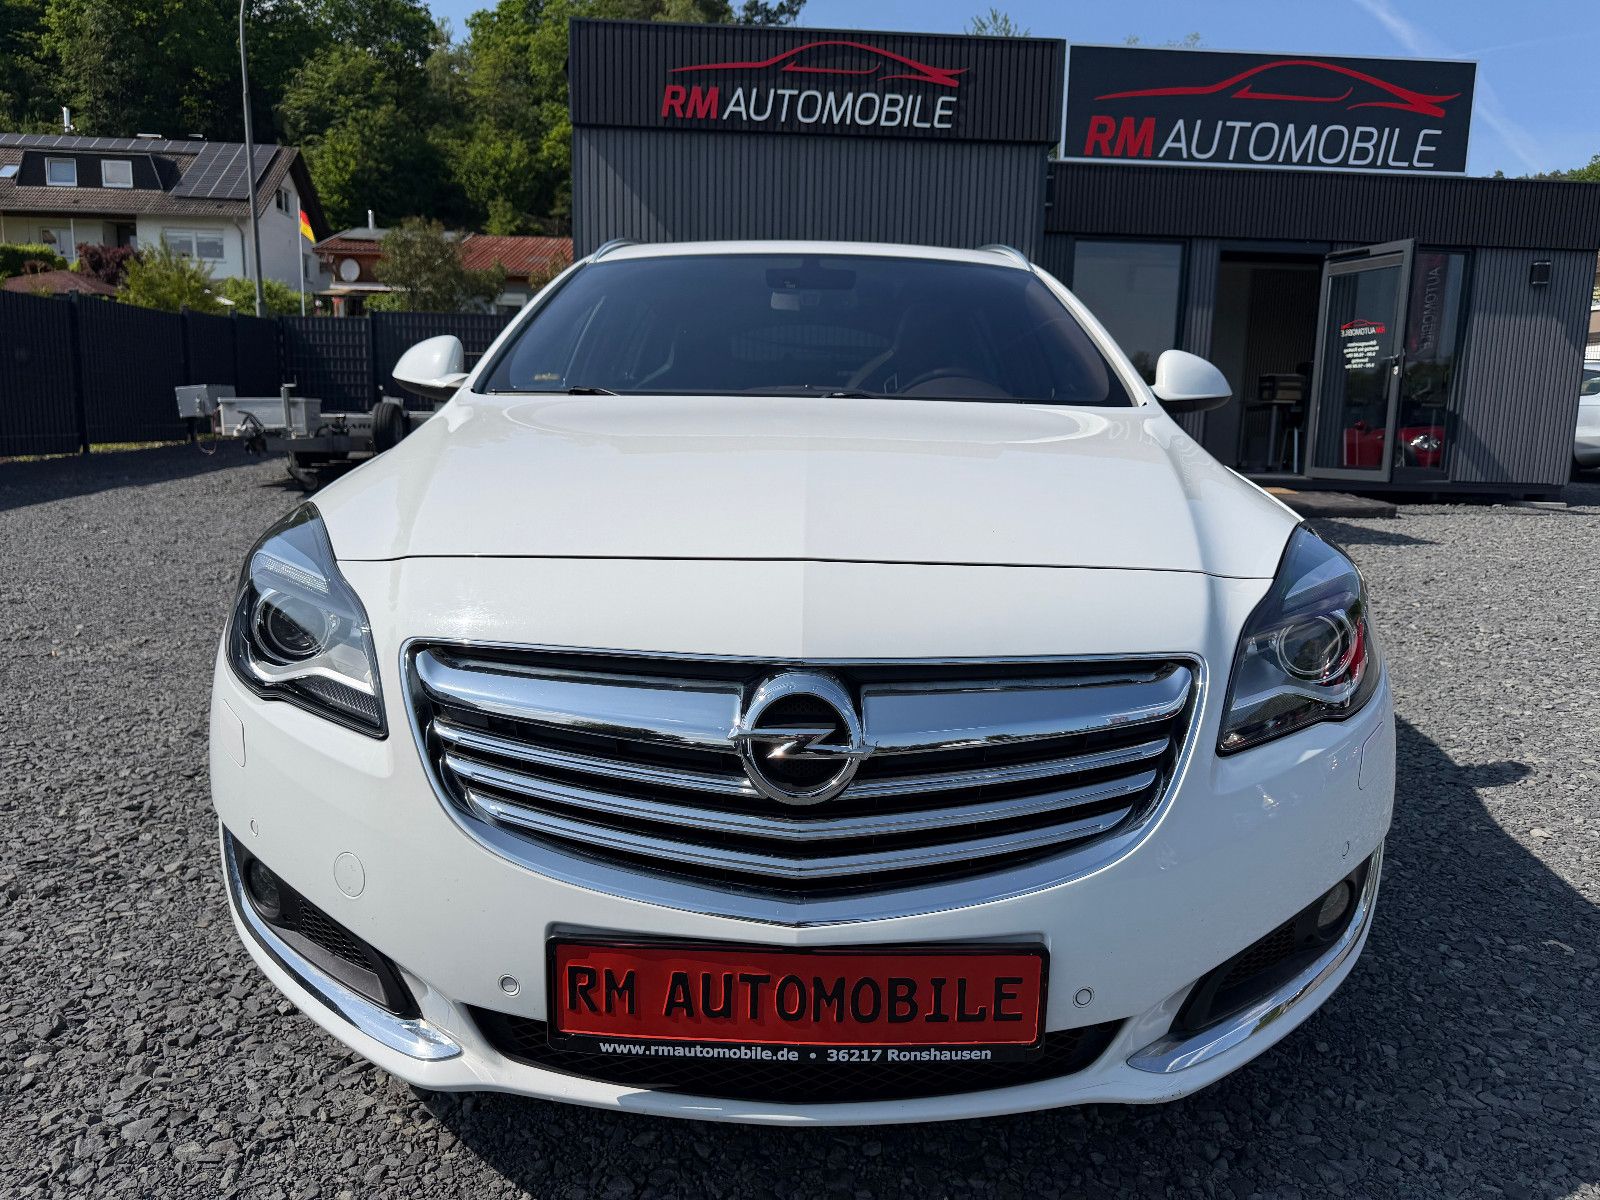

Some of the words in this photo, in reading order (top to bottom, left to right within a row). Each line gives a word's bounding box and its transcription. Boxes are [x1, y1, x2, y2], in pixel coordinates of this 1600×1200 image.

[661, 85, 719, 119] RM
[722, 86, 957, 129] AUTOMOBILE
[1084, 115, 1156, 158] RM
[1158, 118, 1442, 167] AUTOMOBILE
[566, 965, 635, 1014] RM
[662, 971, 1024, 1023] AUTOMOBILE
[599, 1041, 799, 1061] www.rmautomobile.de
[826, 1049, 882, 1062] 36217
[887, 1048, 992, 1061] Ronshausen
